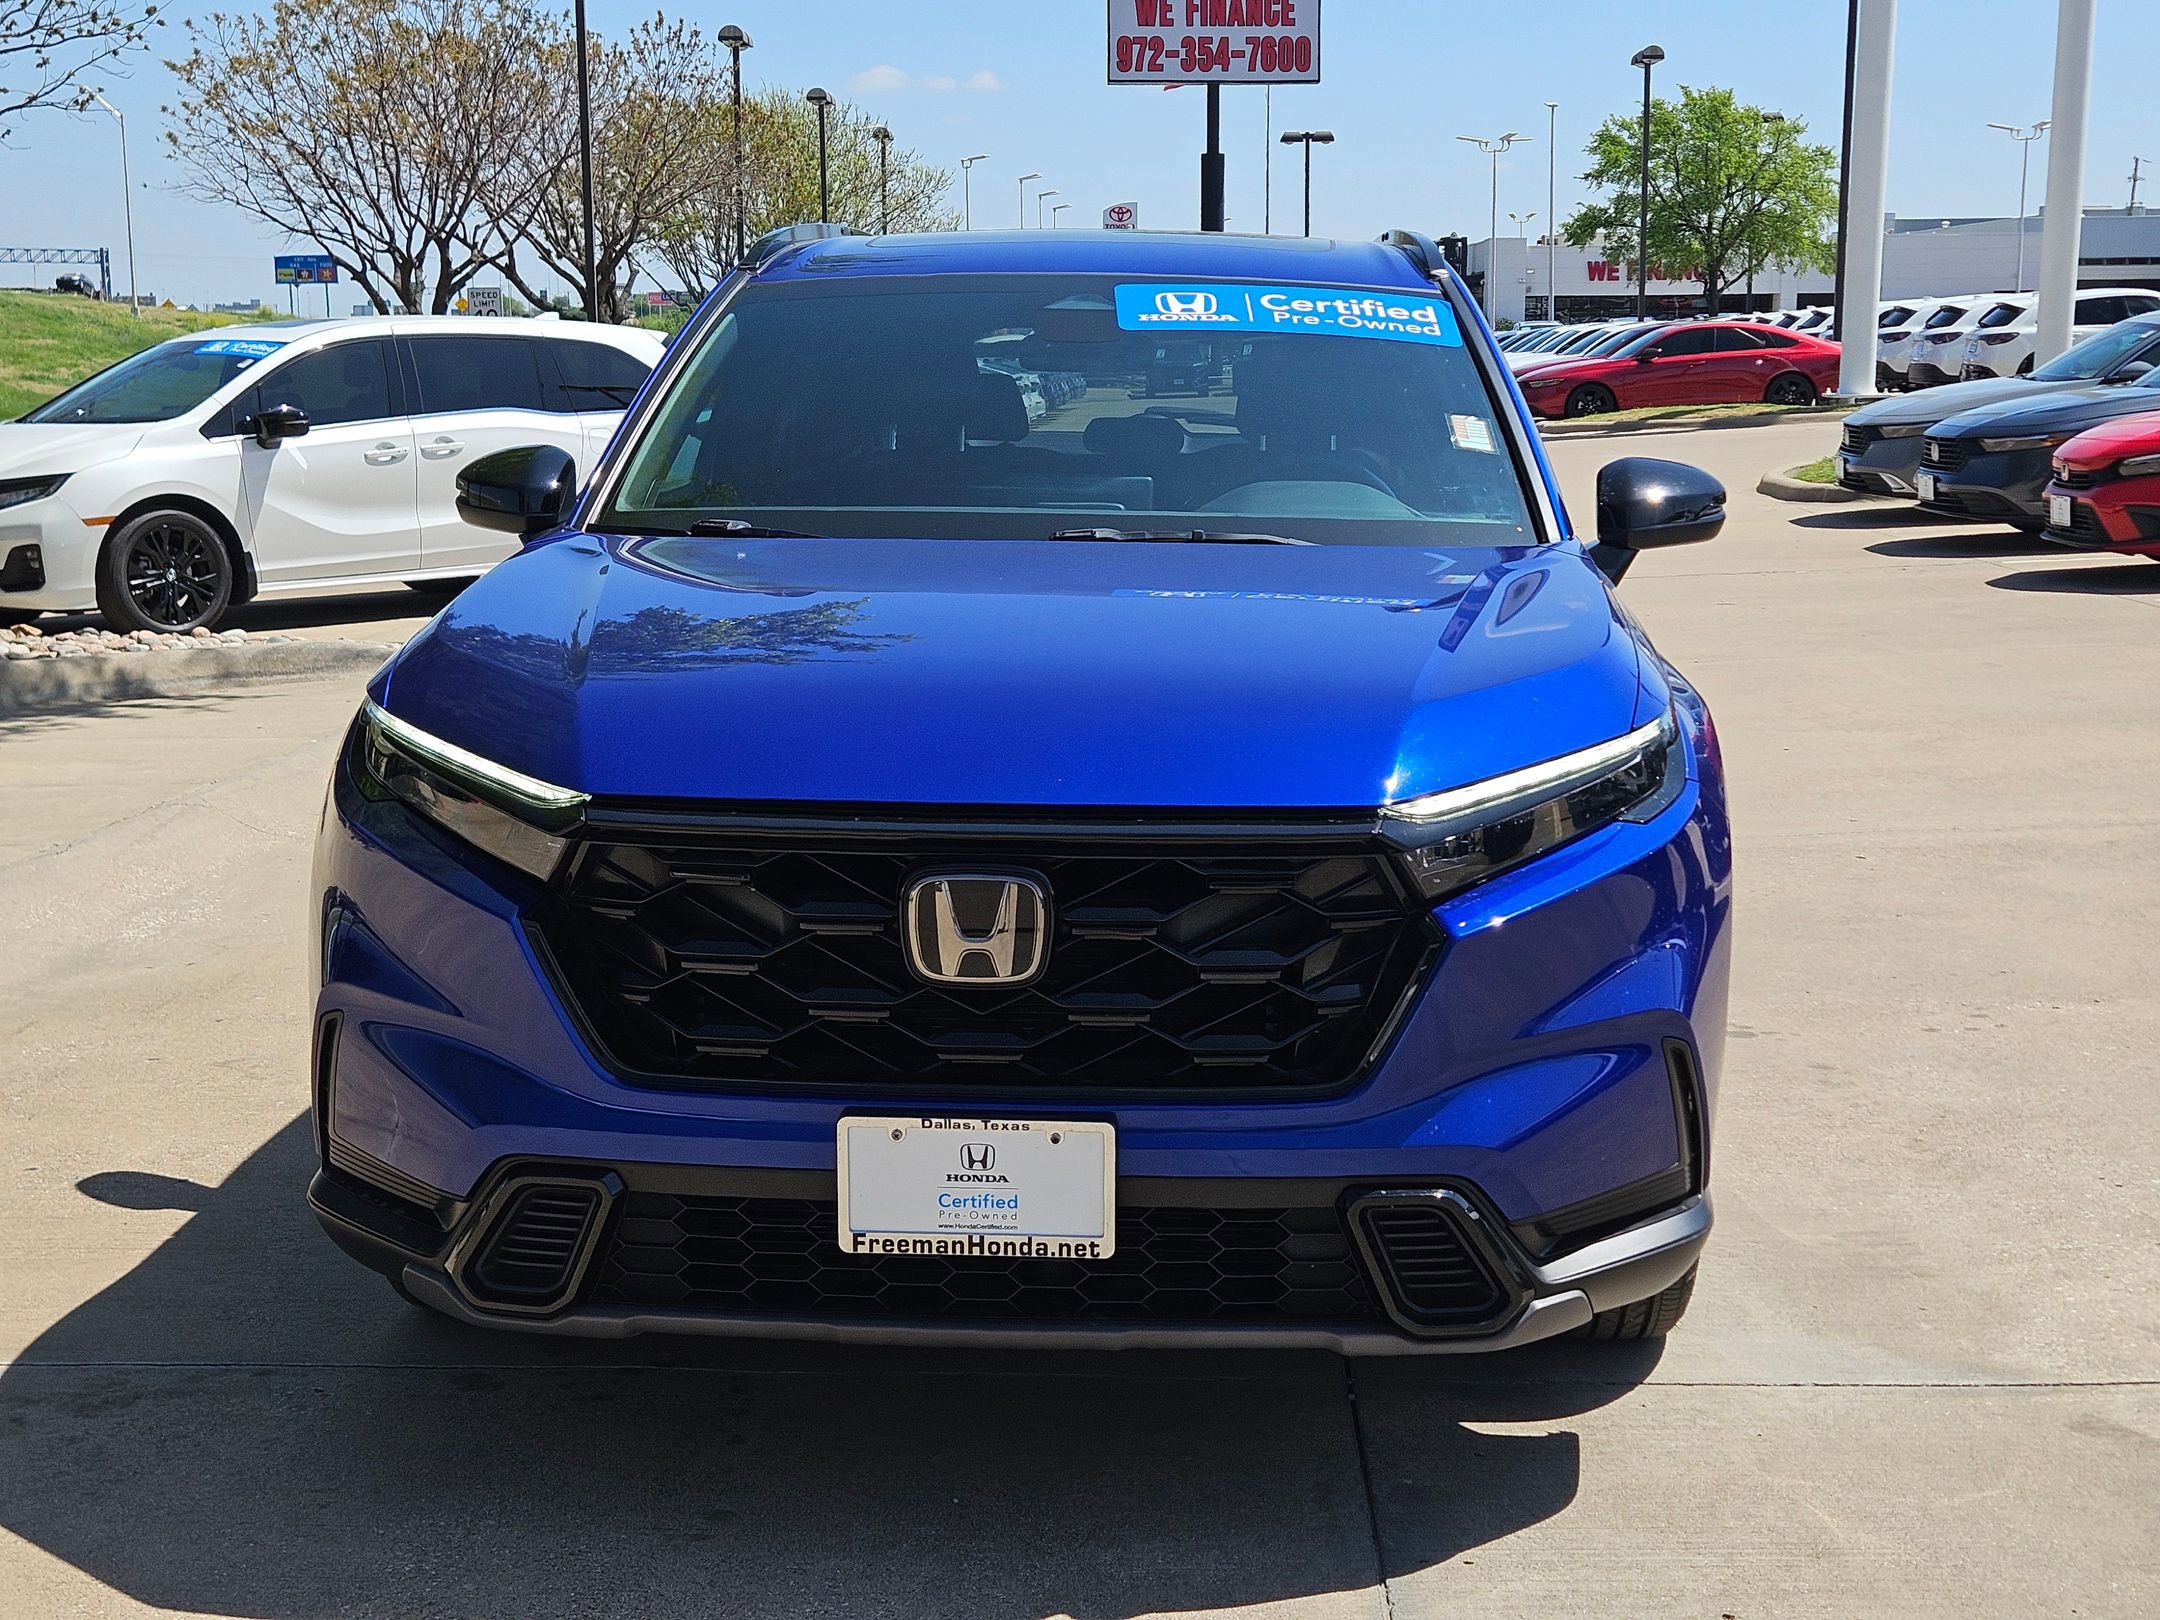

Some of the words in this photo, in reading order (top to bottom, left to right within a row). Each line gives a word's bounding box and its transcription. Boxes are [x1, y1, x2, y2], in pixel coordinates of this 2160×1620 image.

[1134, 0, 1174, 27] WE
[1186, 0, 1296, 27] FINANCE
[1116, 36, 1311, 72] 972-354-7600
[1587, 261, 1620, 281] WE
[470, 291, 498, 299] SPEED
[1138, 313, 1240, 322] HONDA
[1260, 294, 1437, 323] Certified
[1273, 312, 1442, 337] Pre-Owned
[921, 1118, 975, 1130] Dallas,
[981, 1120, 1030, 1131] Texas
[946, 1174, 1009, 1183] HONDA
[938, 1193, 1018, 1209] Certified
[939, 1210, 1018, 1221] Pre-Owned
[852, 1233, 1101, 1258] FreemanHonda.net
